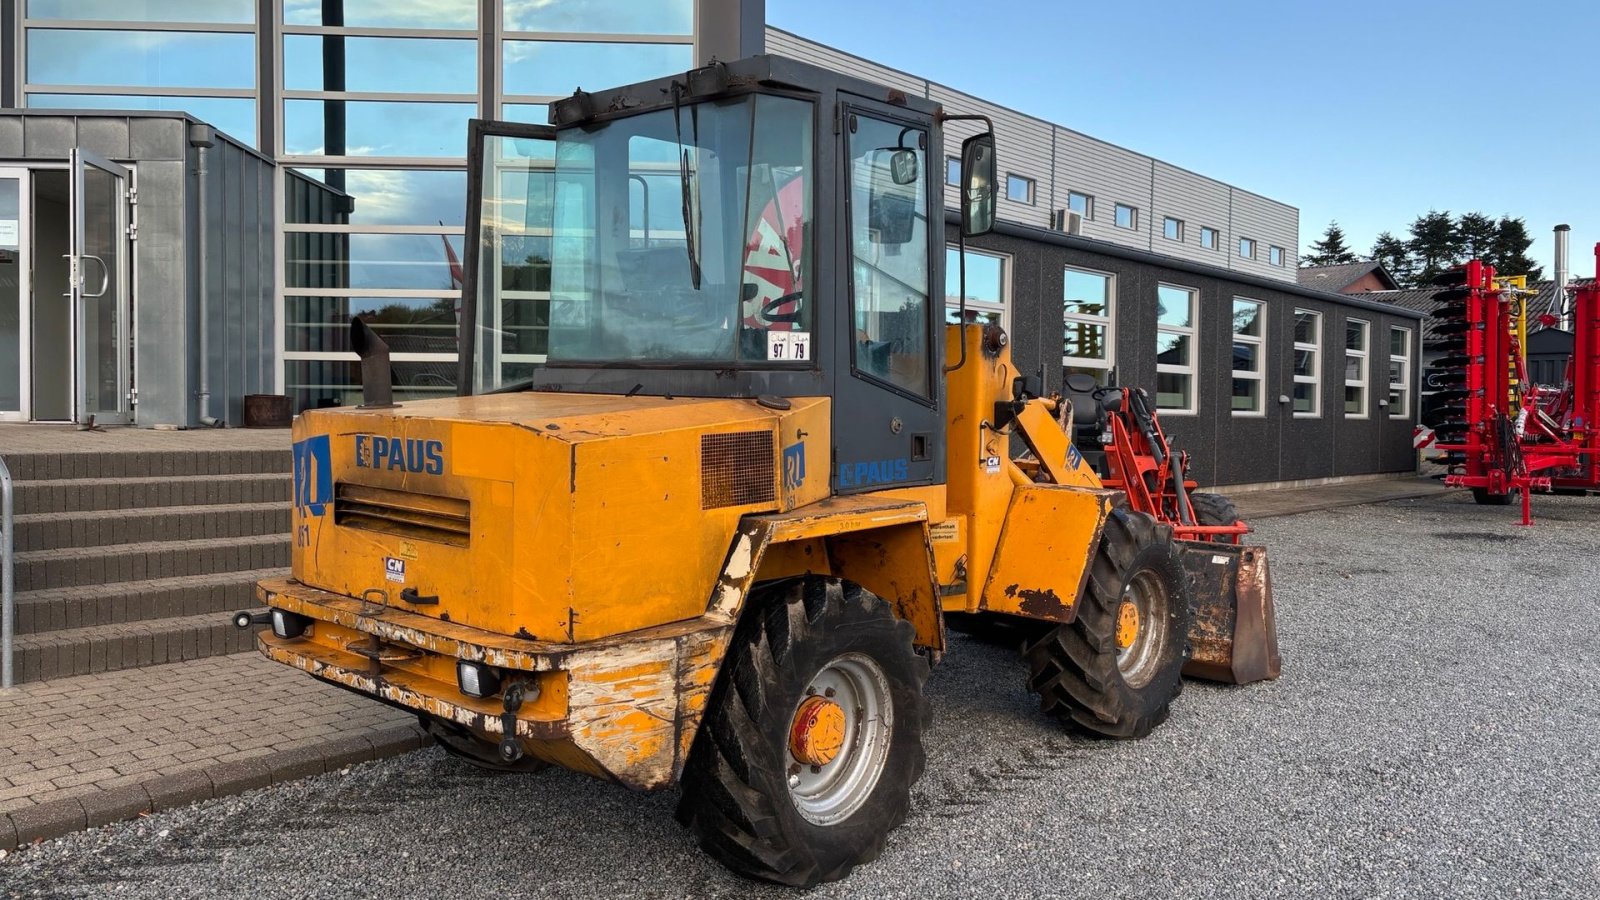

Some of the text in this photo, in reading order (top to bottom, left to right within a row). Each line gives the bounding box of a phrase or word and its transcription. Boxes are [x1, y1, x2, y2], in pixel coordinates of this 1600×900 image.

[773, 343, 783, 358] 97
[794, 343, 804, 359] 79
[372, 435, 443, 476] PAUS
[854, 457, 908, 486] PAUS
[387, 558, 404, 572] CN
